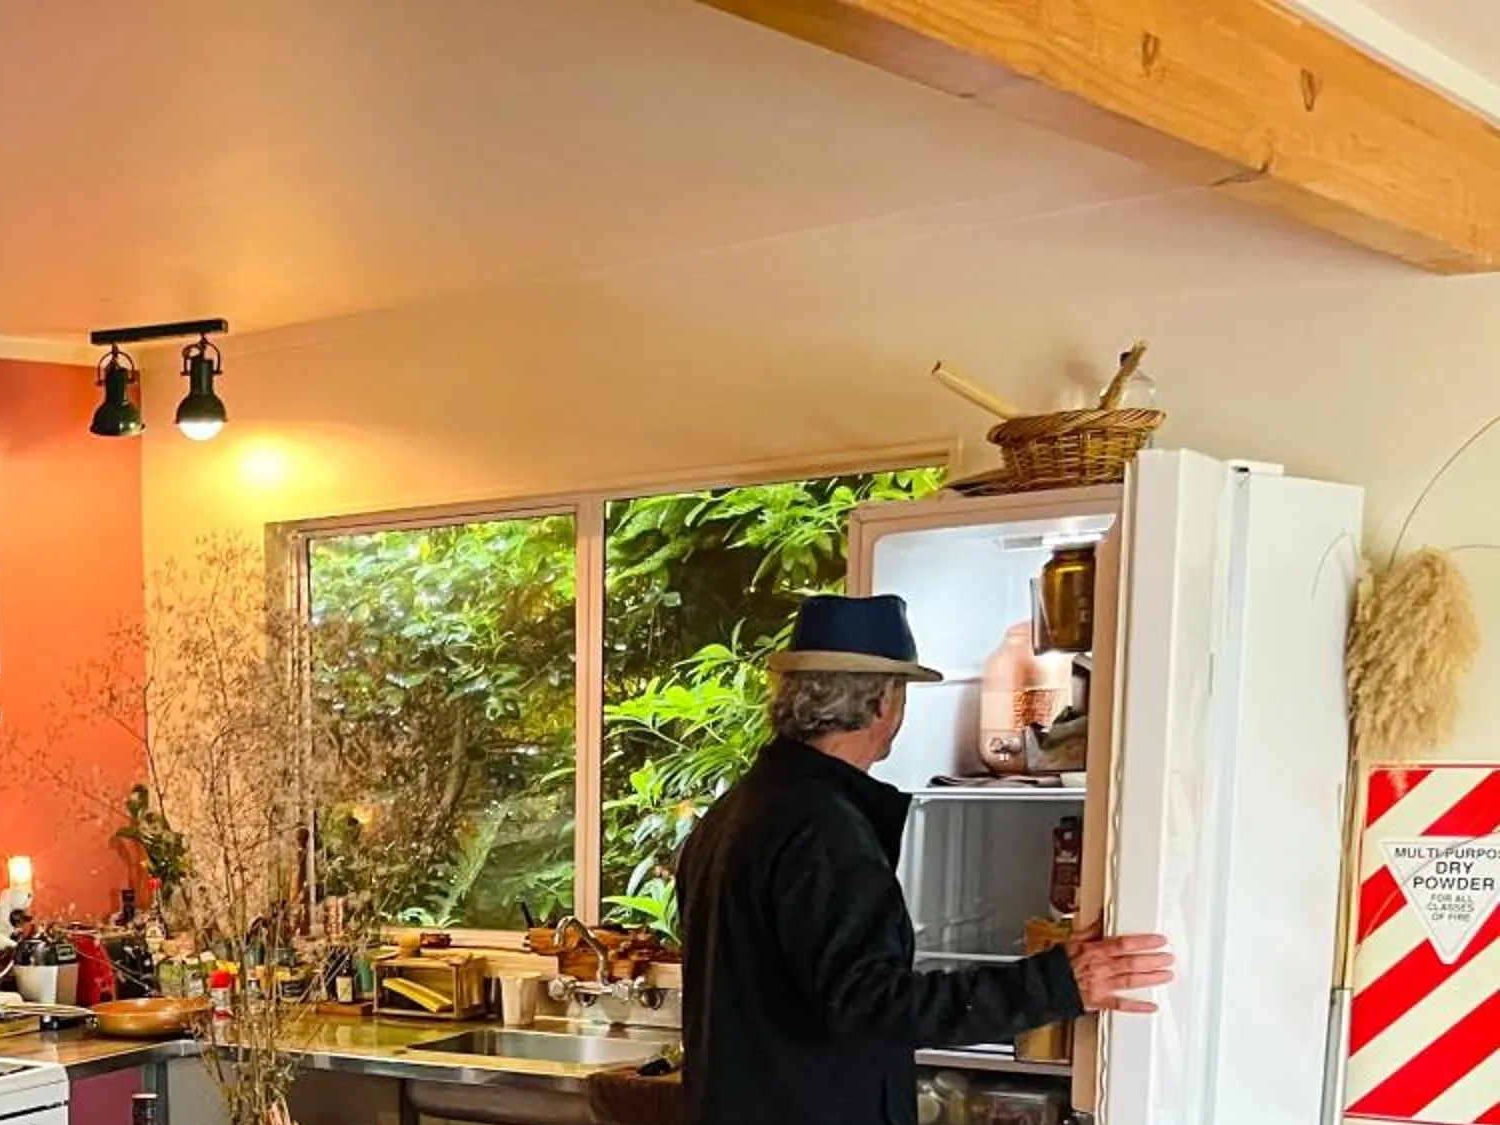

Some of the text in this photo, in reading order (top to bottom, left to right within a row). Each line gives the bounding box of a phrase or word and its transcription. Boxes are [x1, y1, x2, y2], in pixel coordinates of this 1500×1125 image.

[1435, 861, 1474, 875] DRY
[1413, 876, 1495, 891] POWDER
[1431, 893, 1473, 903] FOR ALL
[1427, 902, 1475, 913] CLASSES
[1431, 912, 1471, 921] OF FIRE
